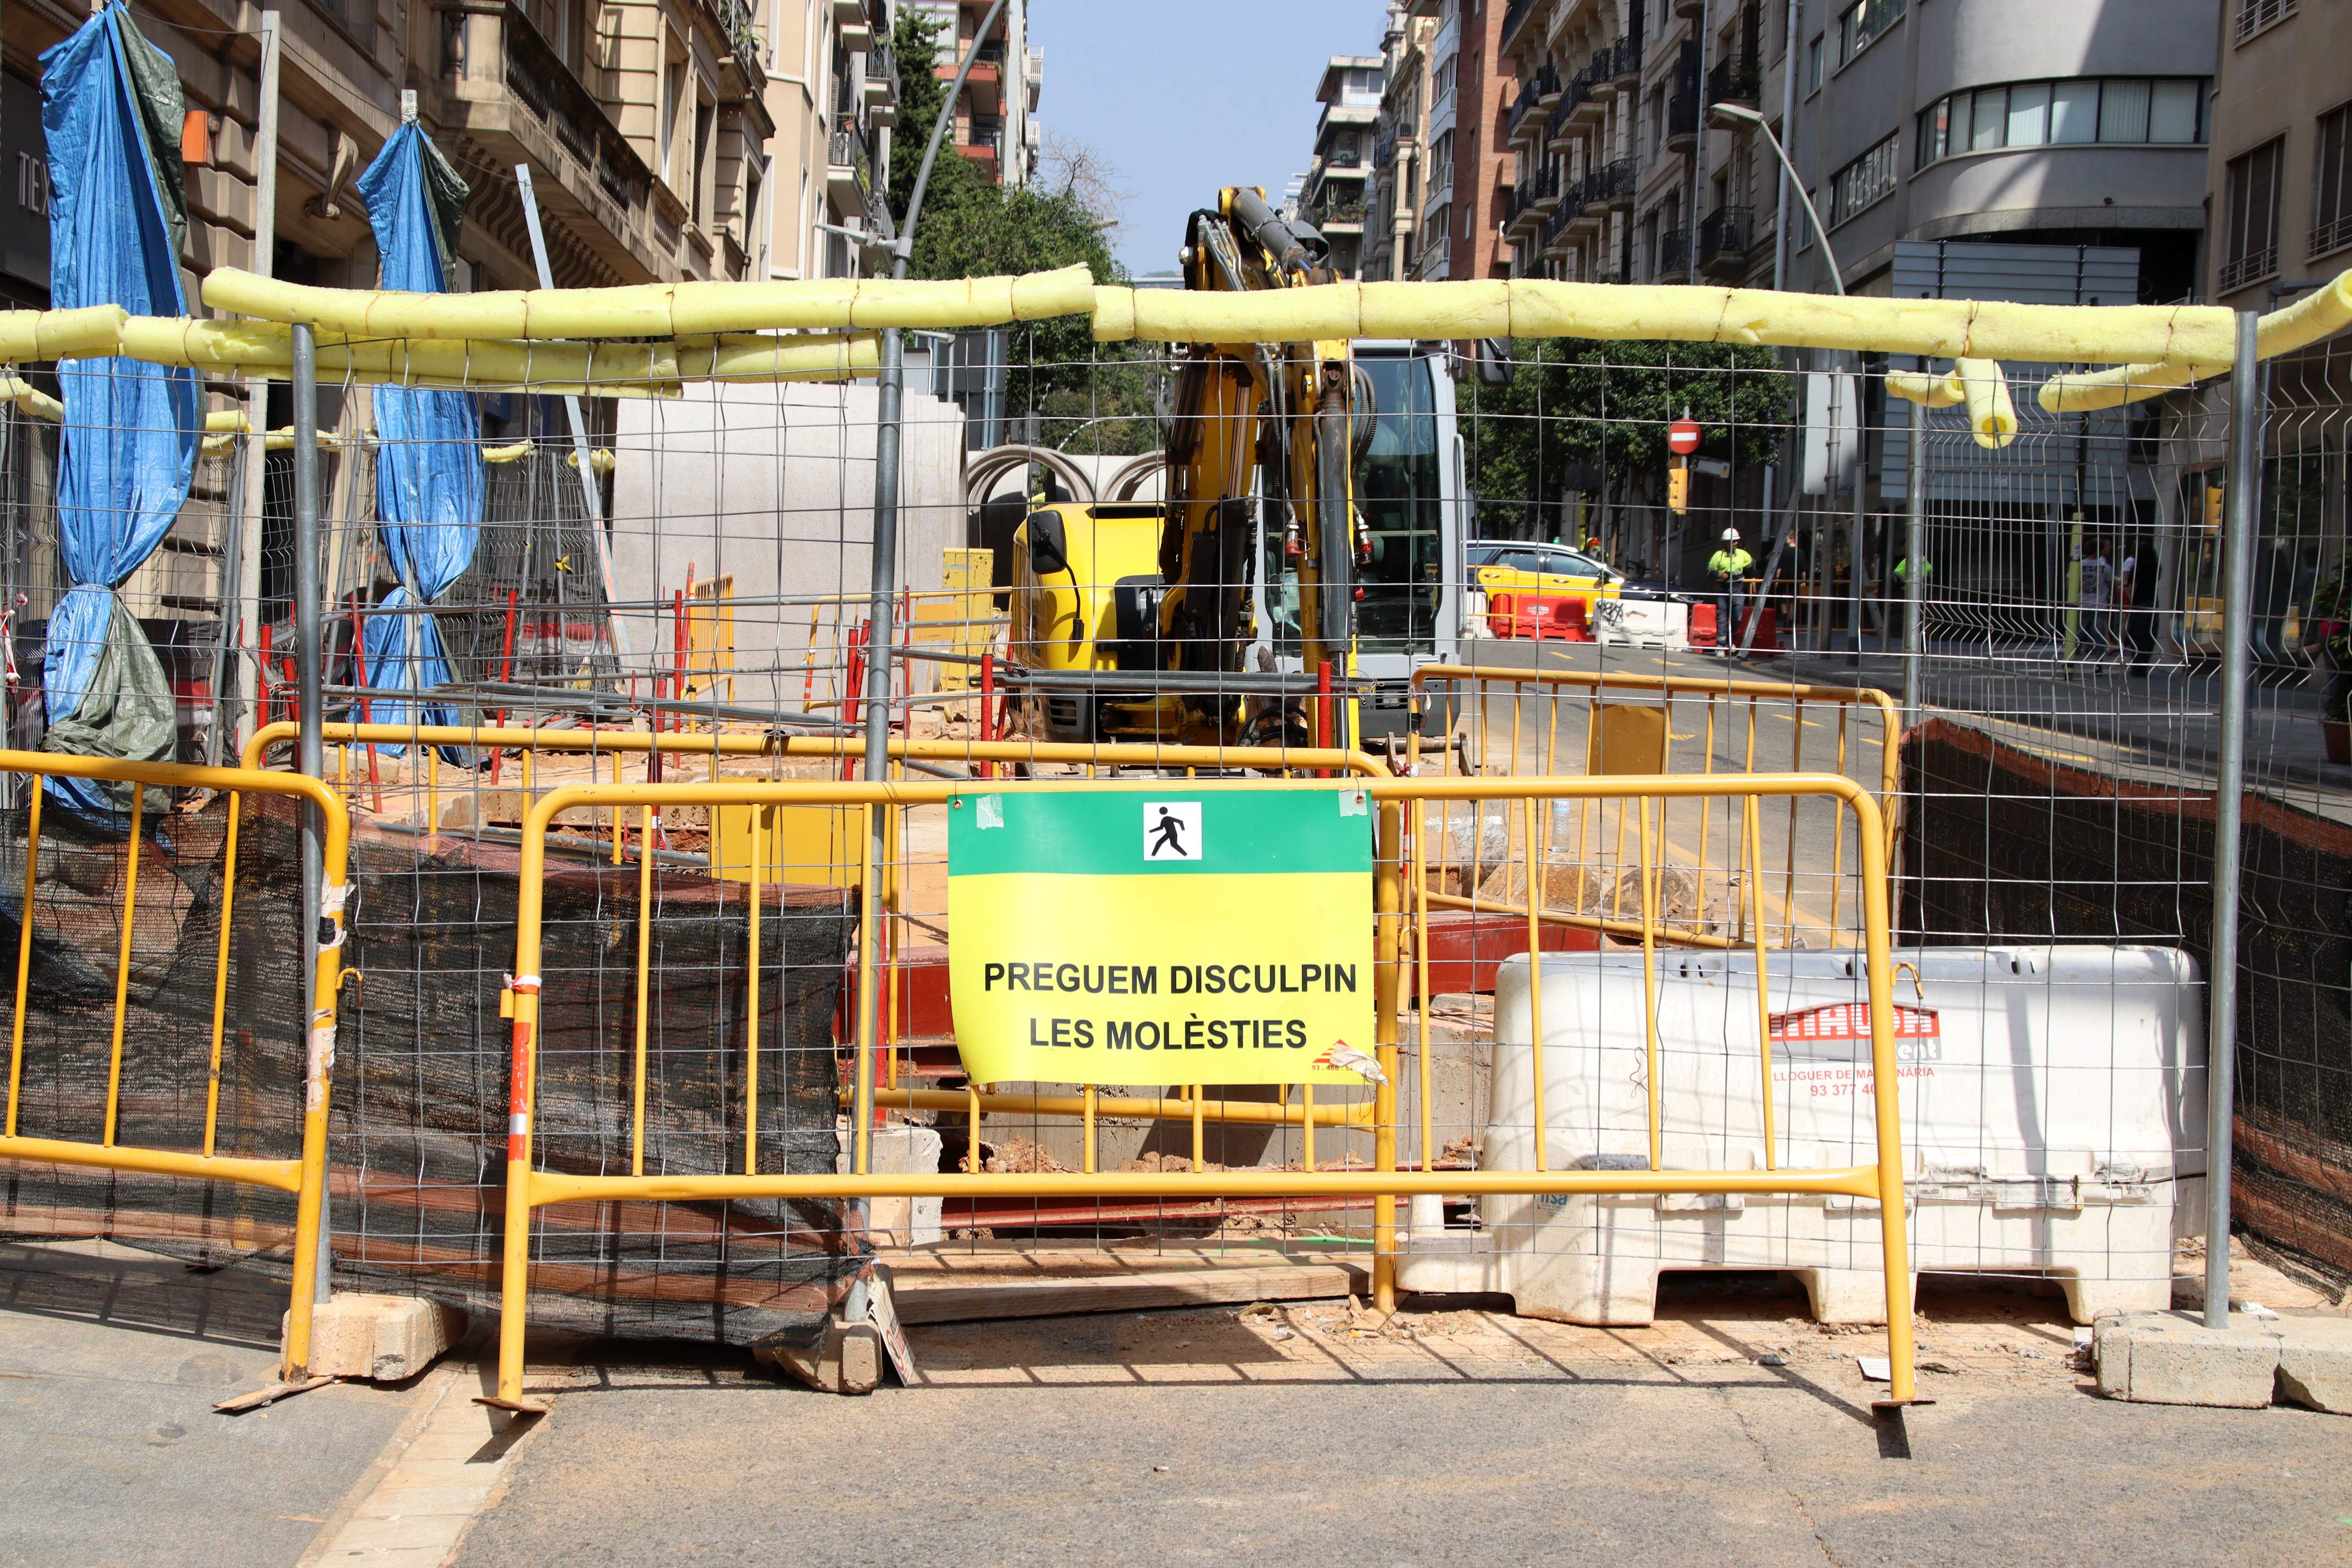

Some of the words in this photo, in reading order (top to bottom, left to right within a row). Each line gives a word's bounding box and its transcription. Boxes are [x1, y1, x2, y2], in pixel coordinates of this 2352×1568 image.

[984, 962, 1157, 994] PREGUEM
[1170, 963, 1356, 994] DISCULPIN
[1030, 1017, 1094, 1048] LES
[1107, 1013, 1307, 1050] MOLÈSTIES
[1896, 1039, 1937, 1060] ent
[1774, 1070, 1832, 1081] LLOGUER
[1836, 1070, 1852, 1079] DE
[1856, 1066, 1935, 1078] MANÀRIA
[1810, 1085, 1827, 1096] 93
[1832, 1084, 1856, 1096] 377
